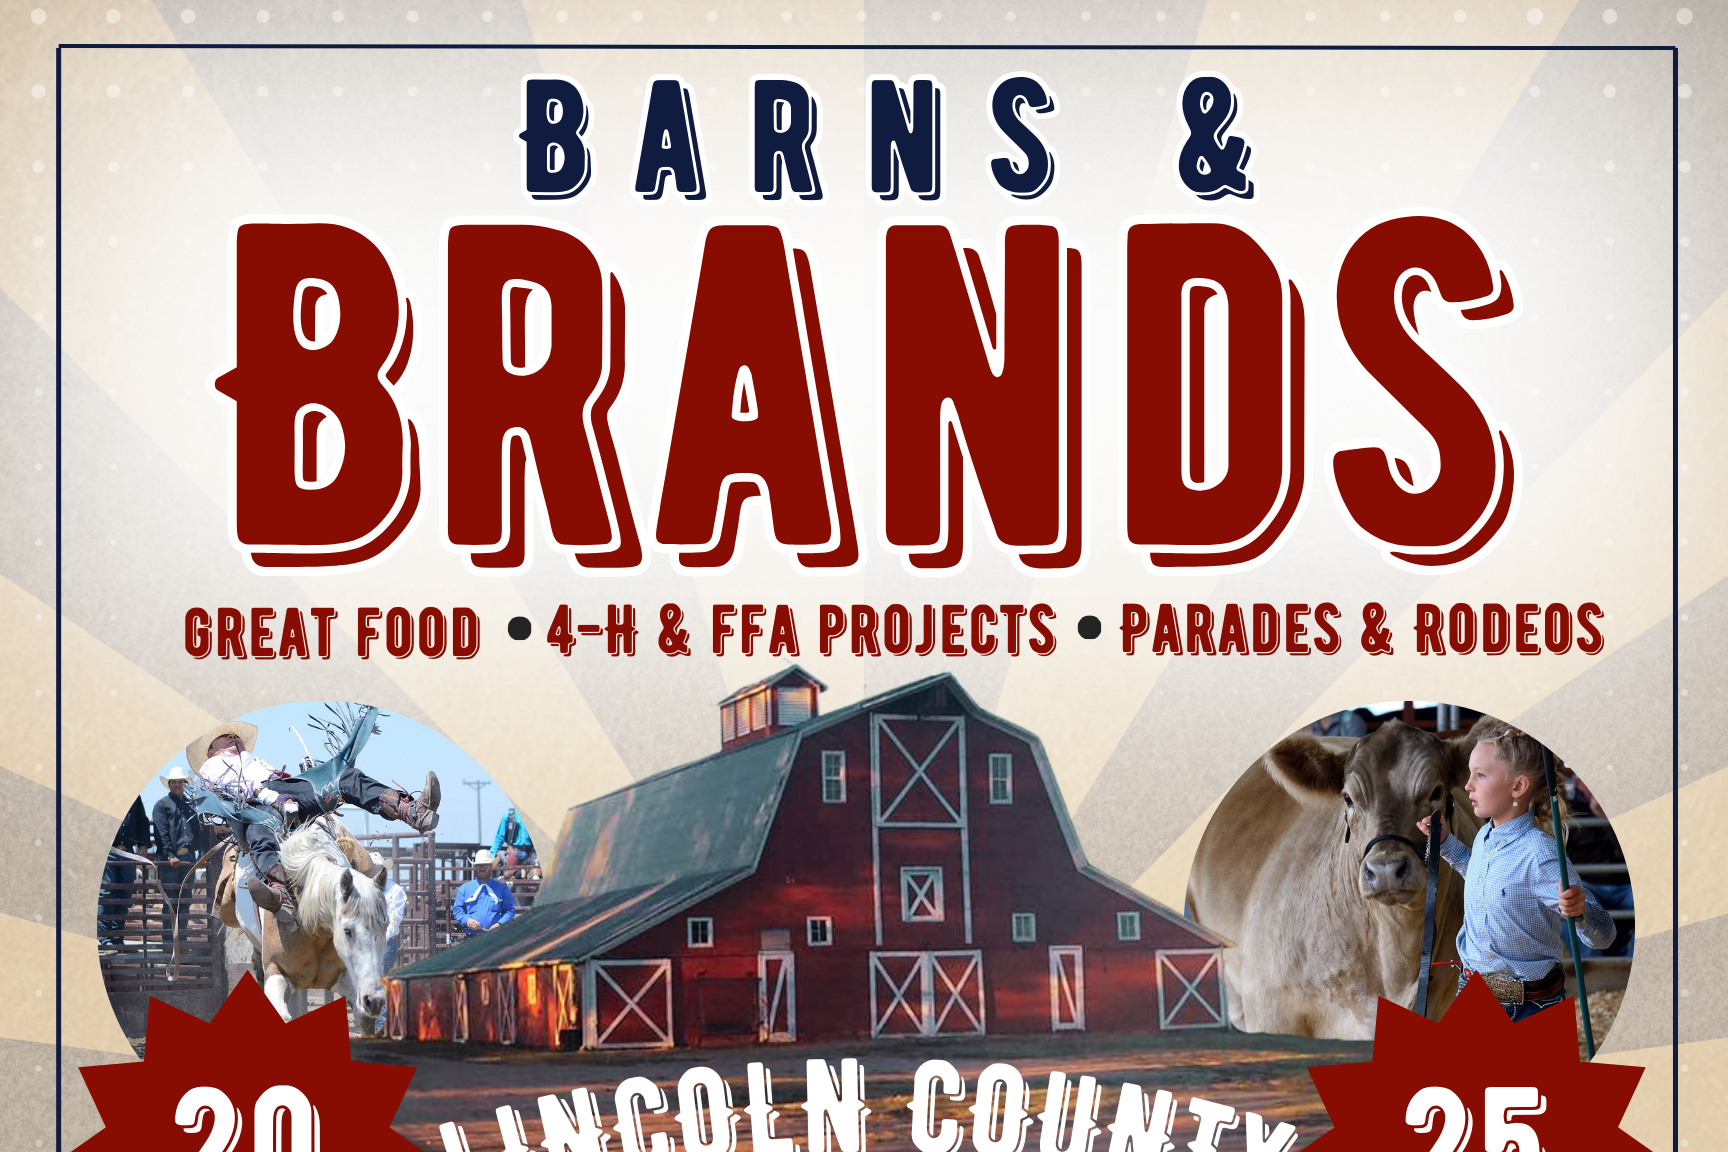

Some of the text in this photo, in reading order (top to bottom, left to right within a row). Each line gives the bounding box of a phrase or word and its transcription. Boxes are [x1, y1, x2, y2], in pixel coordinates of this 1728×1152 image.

[519, 77, 1254, 200] BARNS &
[215, 216, 1514, 568] BRANDS
[186, 603, 1604, 659] GREAT FOOD 4-H & FFA PROJECTS PARADES & RODEOS
